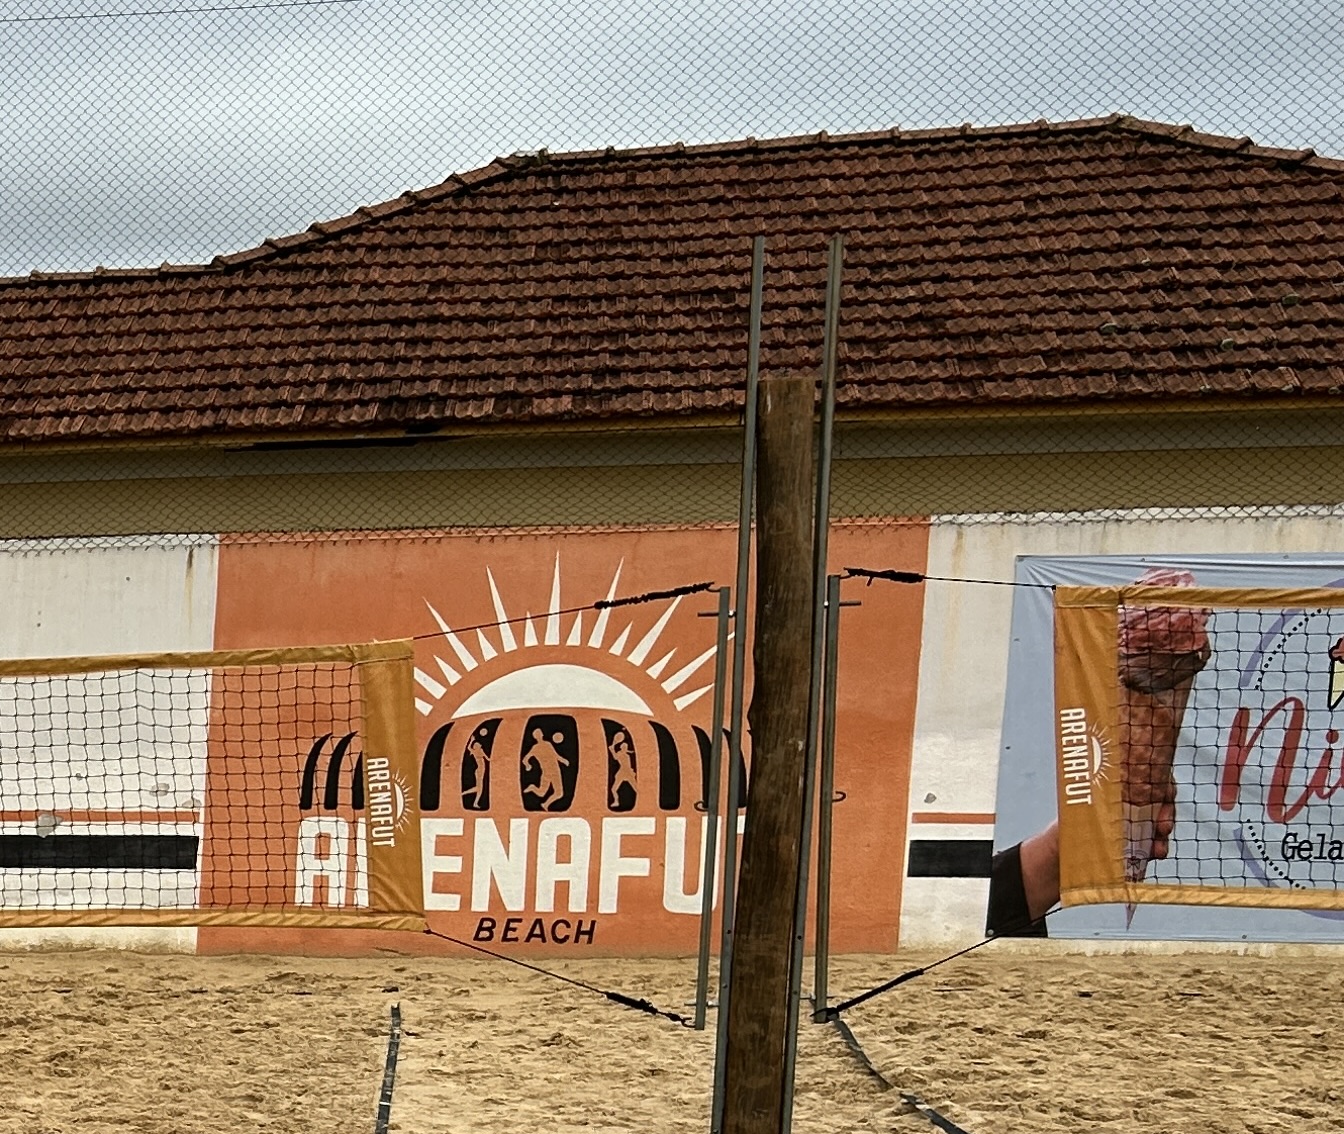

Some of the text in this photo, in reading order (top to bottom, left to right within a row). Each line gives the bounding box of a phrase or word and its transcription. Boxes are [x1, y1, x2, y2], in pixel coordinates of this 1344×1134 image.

[367, 757, 395, 848] ARENAFUT
[1060, 708, 1092, 805] ARENAFUT
[1220, 697, 1344, 823] Ni
[294, 815, 747, 915] AENAFU
[472, 917, 597, 945] BEACH
